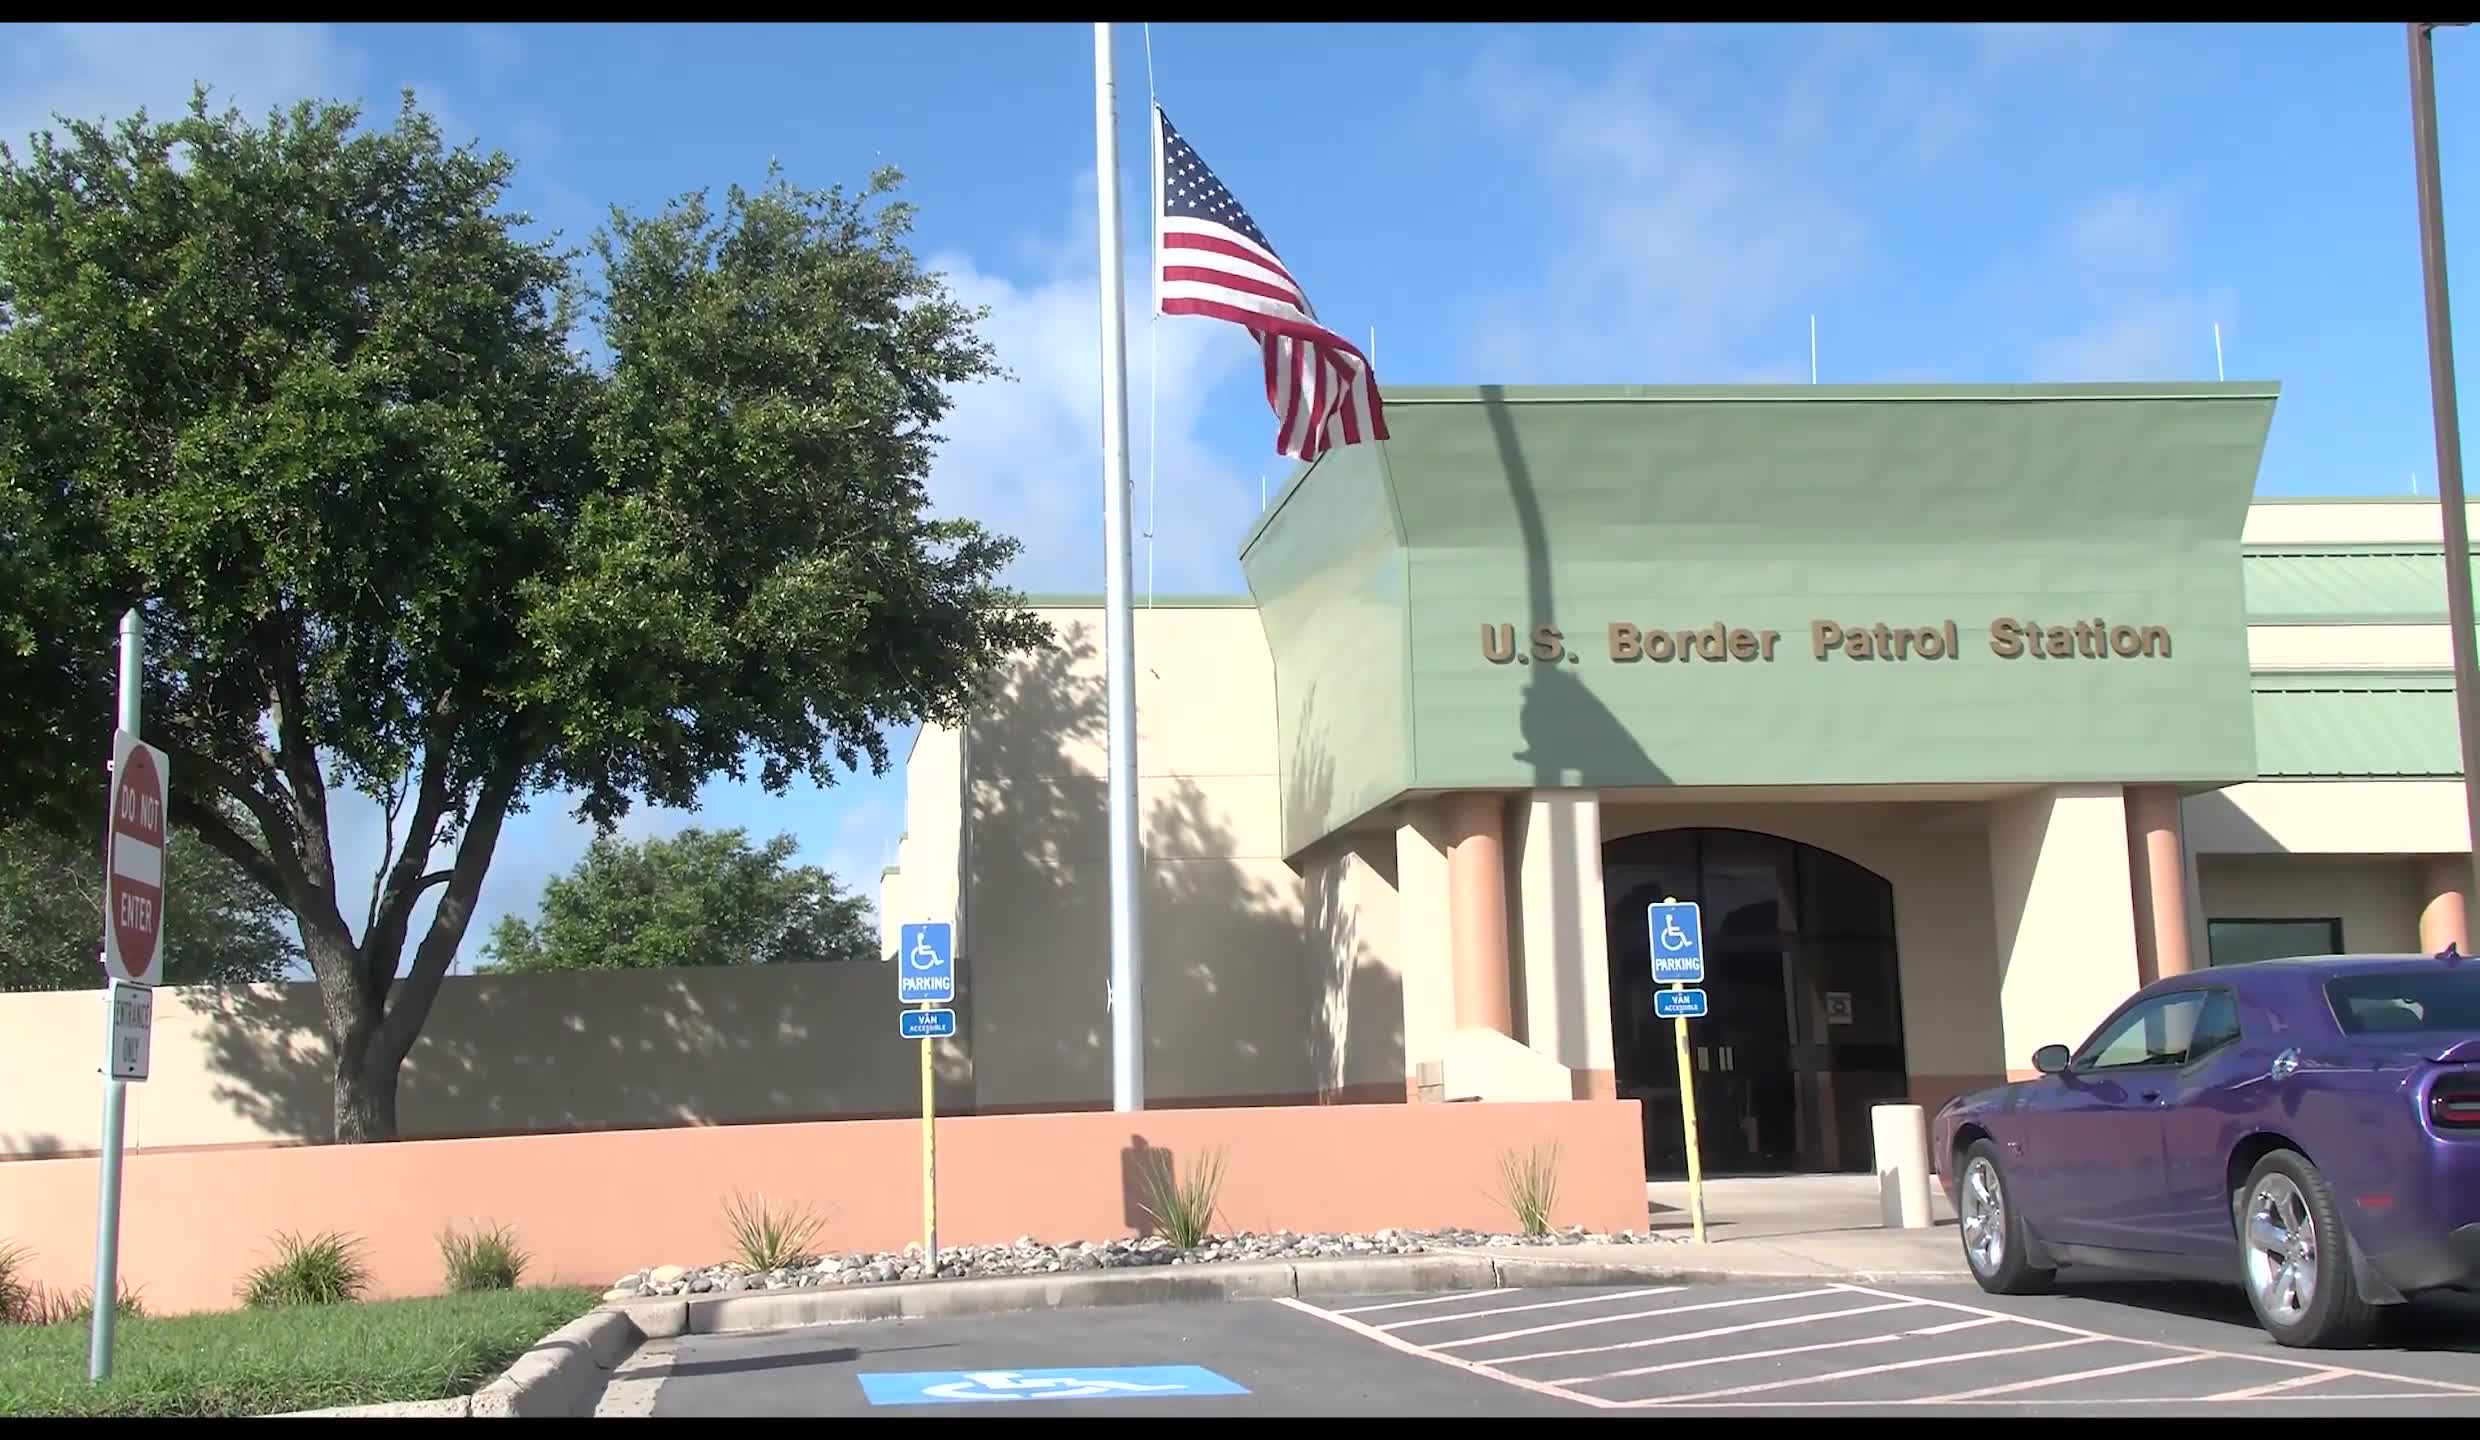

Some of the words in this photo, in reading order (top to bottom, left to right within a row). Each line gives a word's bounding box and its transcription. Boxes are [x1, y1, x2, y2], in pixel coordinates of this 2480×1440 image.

[1480, 622, 1579, 665] U.S.
[1607, 620, 1781, 664] Border
[1810, 618, 1959, 662] Patrol
[1989, 616, 2172, 660] Station
[121, 784, 136, 823] DO
[140, 792, 160, 833] NOT
[120, 891, 152, 934] ENTER
[1655, 957, 1700, 972] PARKING
[902, 976, 950, 992] PARKING
[1671, 995, 1691, 1005] VAN
[918, 1014, 938, 1025] VAN
